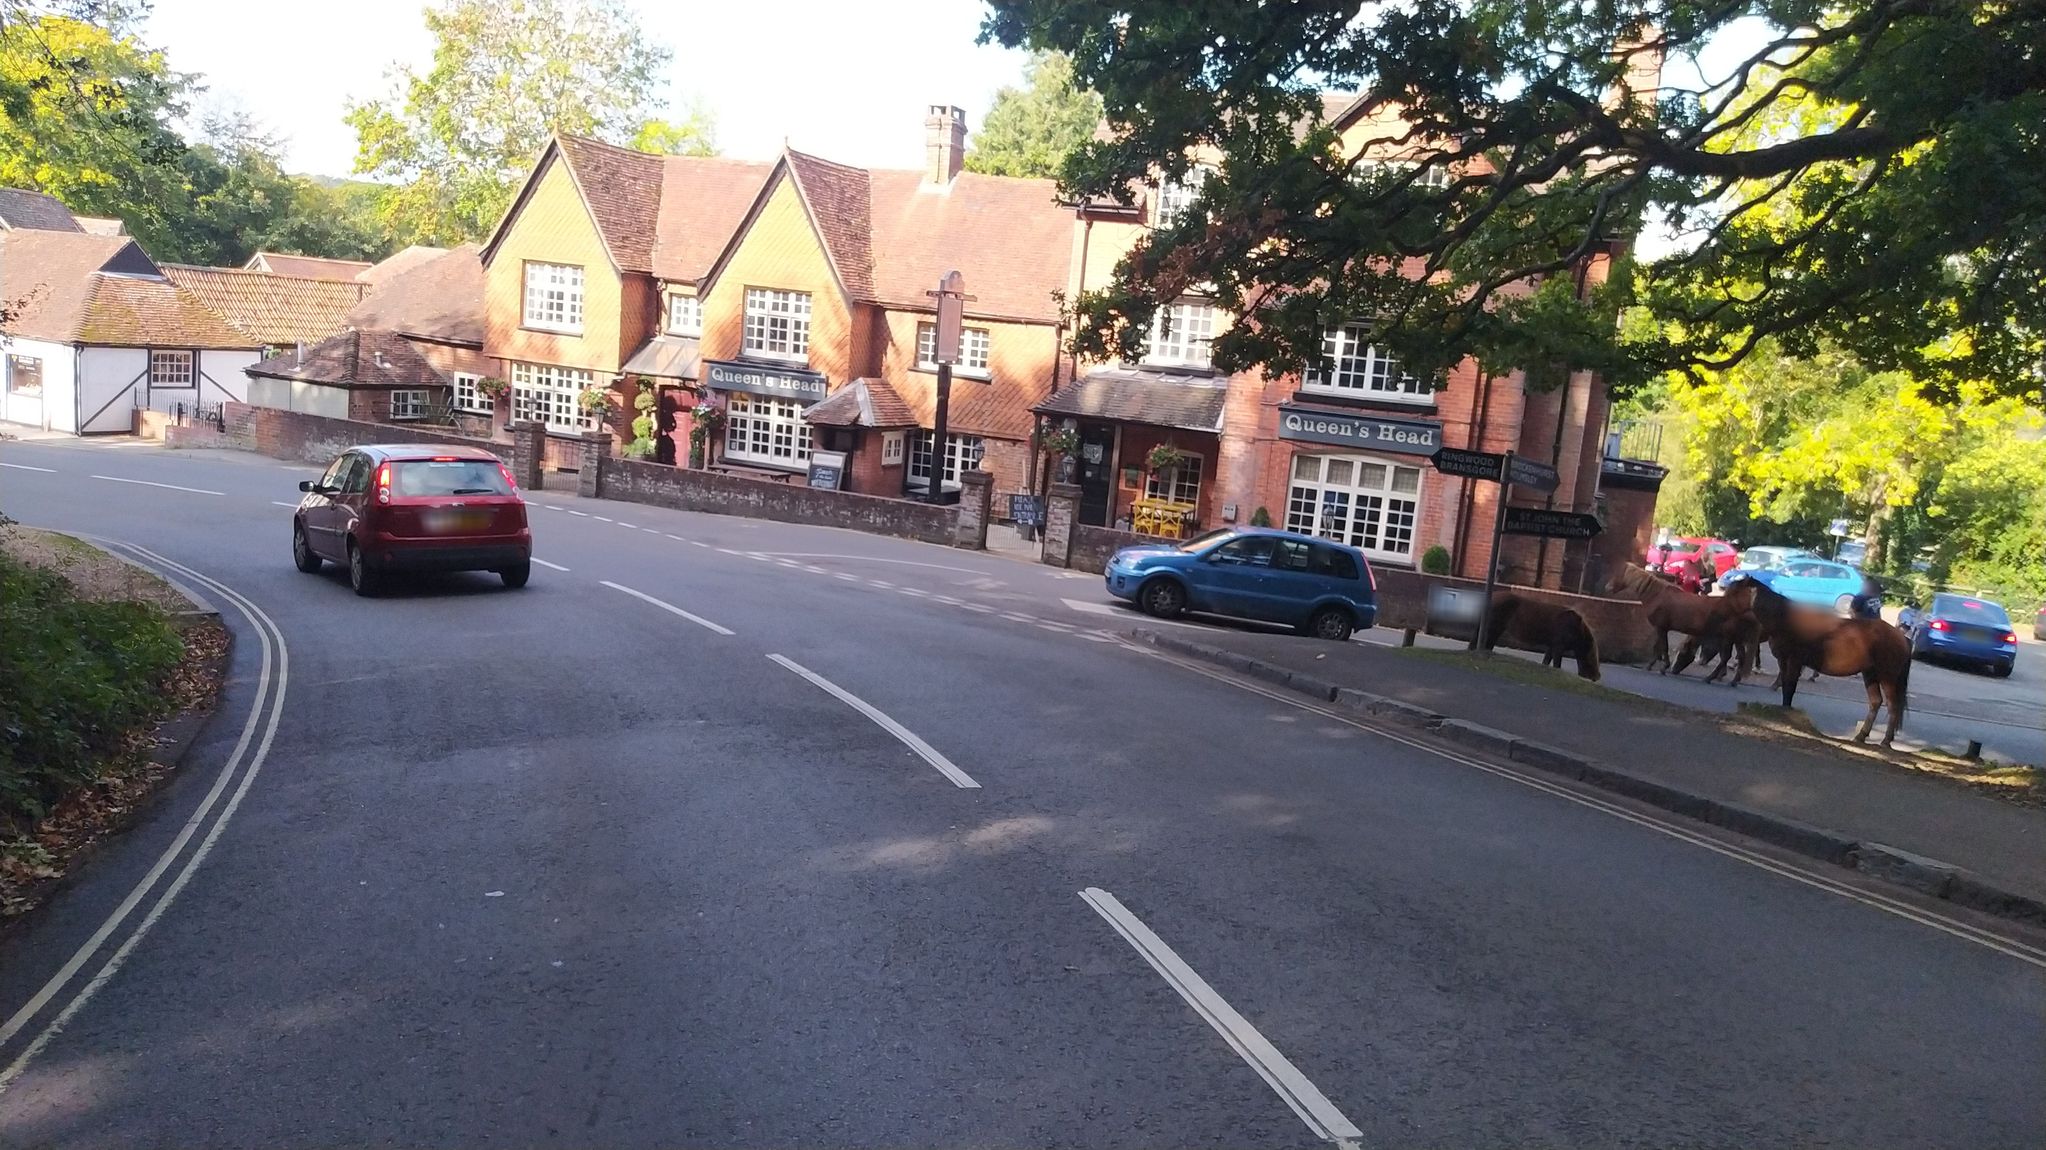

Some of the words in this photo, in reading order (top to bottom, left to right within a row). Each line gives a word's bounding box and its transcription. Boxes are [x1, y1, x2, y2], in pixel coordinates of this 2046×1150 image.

[711, 368, 774, 387] Queen's
[779, 376, 820, 392] Head
[1285, 414, 1369, 438] Queen's
[1377, 425, 1433, 446] Head
[1441, 451, 1494, 466] RINGWOOD
